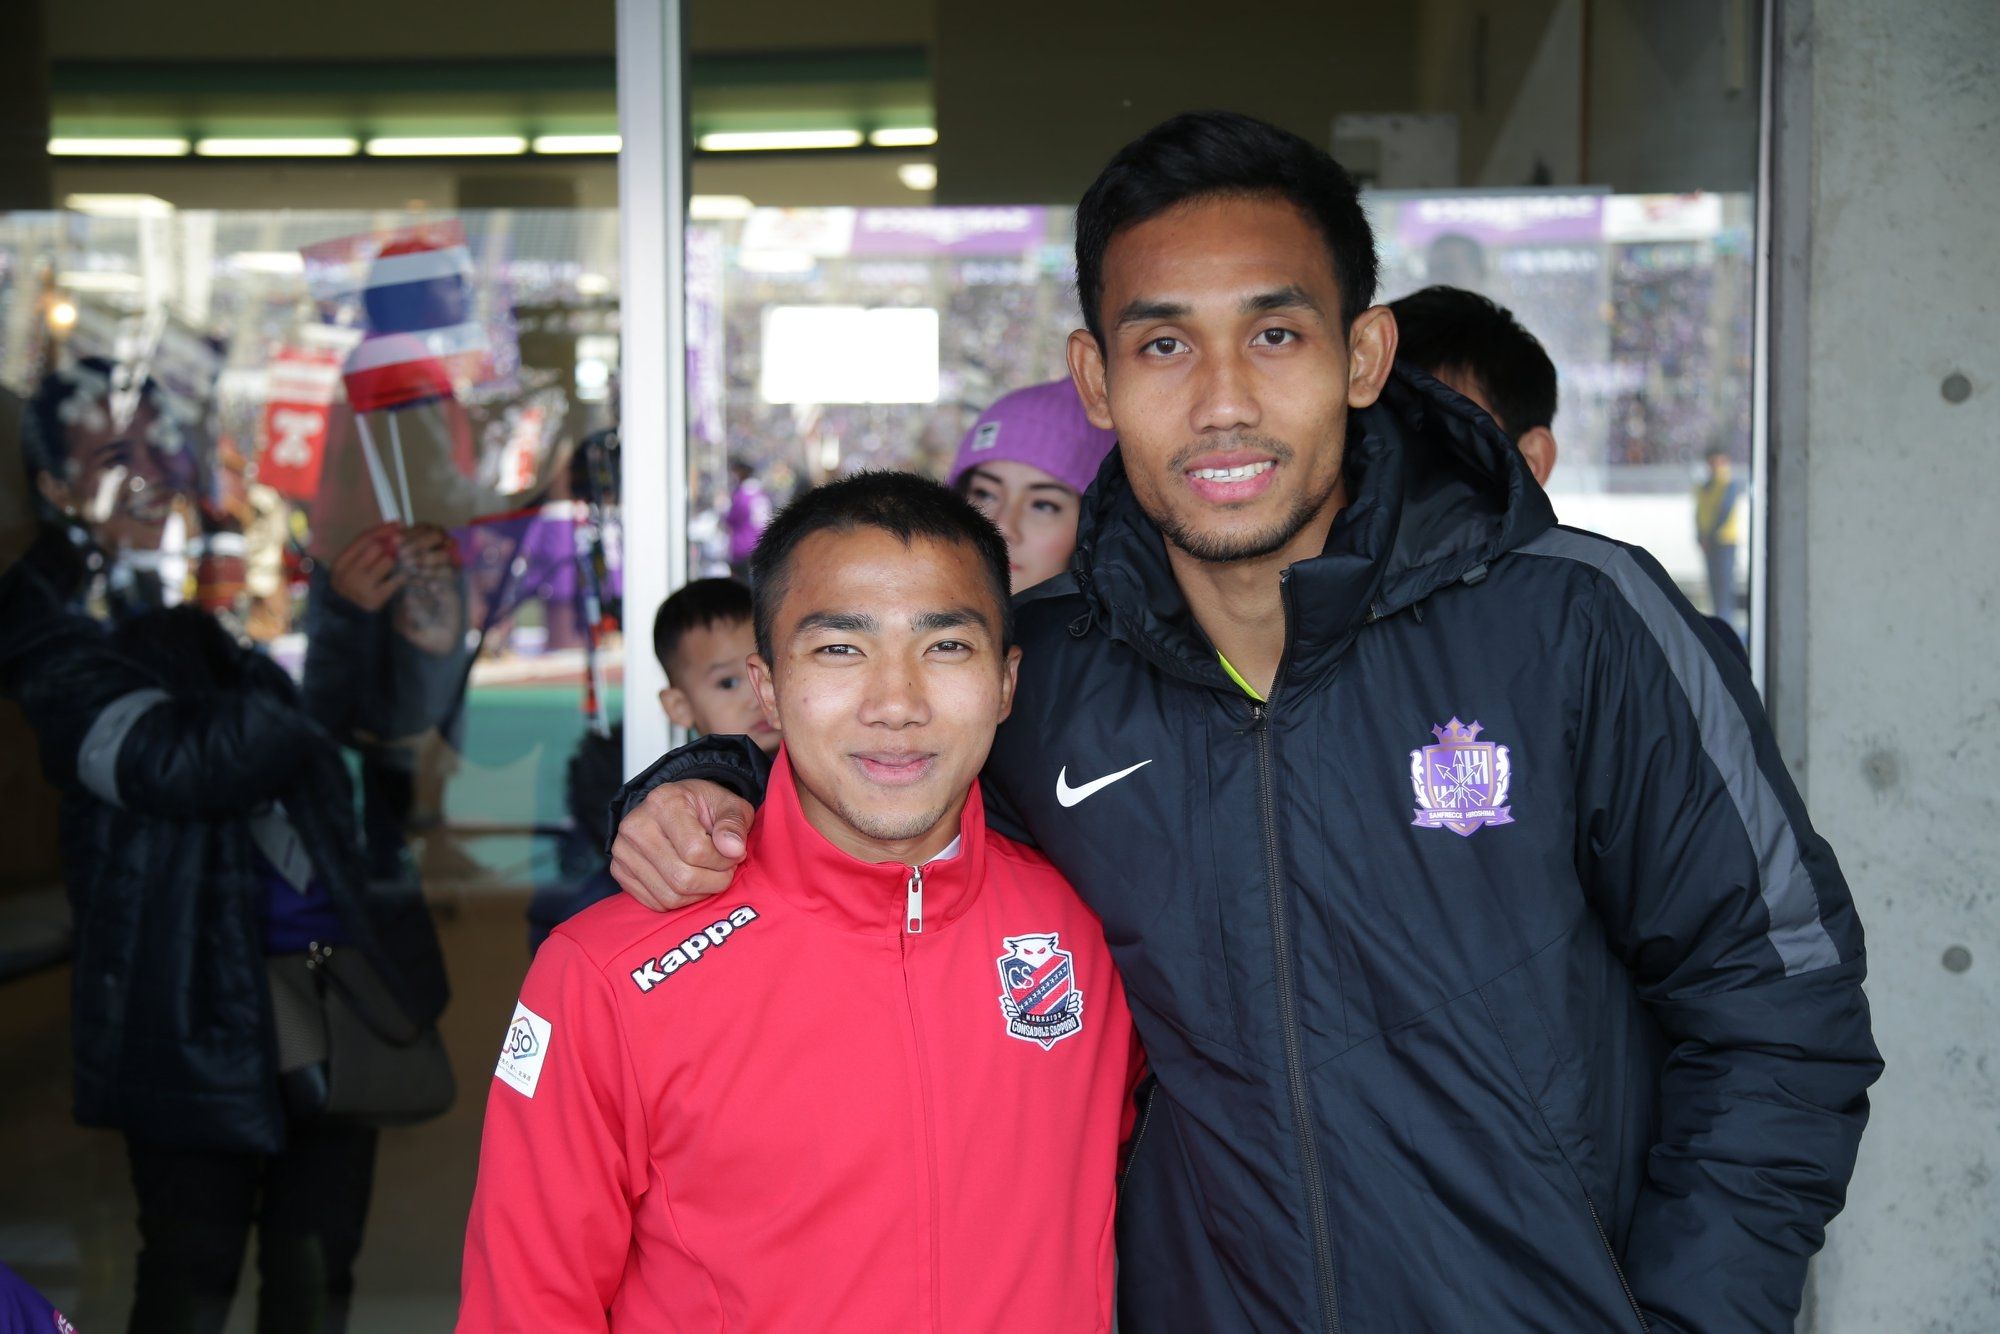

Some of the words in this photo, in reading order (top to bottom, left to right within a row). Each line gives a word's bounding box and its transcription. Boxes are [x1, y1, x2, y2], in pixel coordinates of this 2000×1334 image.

[1465, 810, 1495, 819] HIROSHIMA
[631, 905, 759, 993] Kappa
[1008, 965, 1034, 989] CS
[1012, 1020, 1049, 1037] CONSADOLE
[1050, 1016, 1077, 1036] SAPPORO
[511, 1026, 532, 1053] 150
